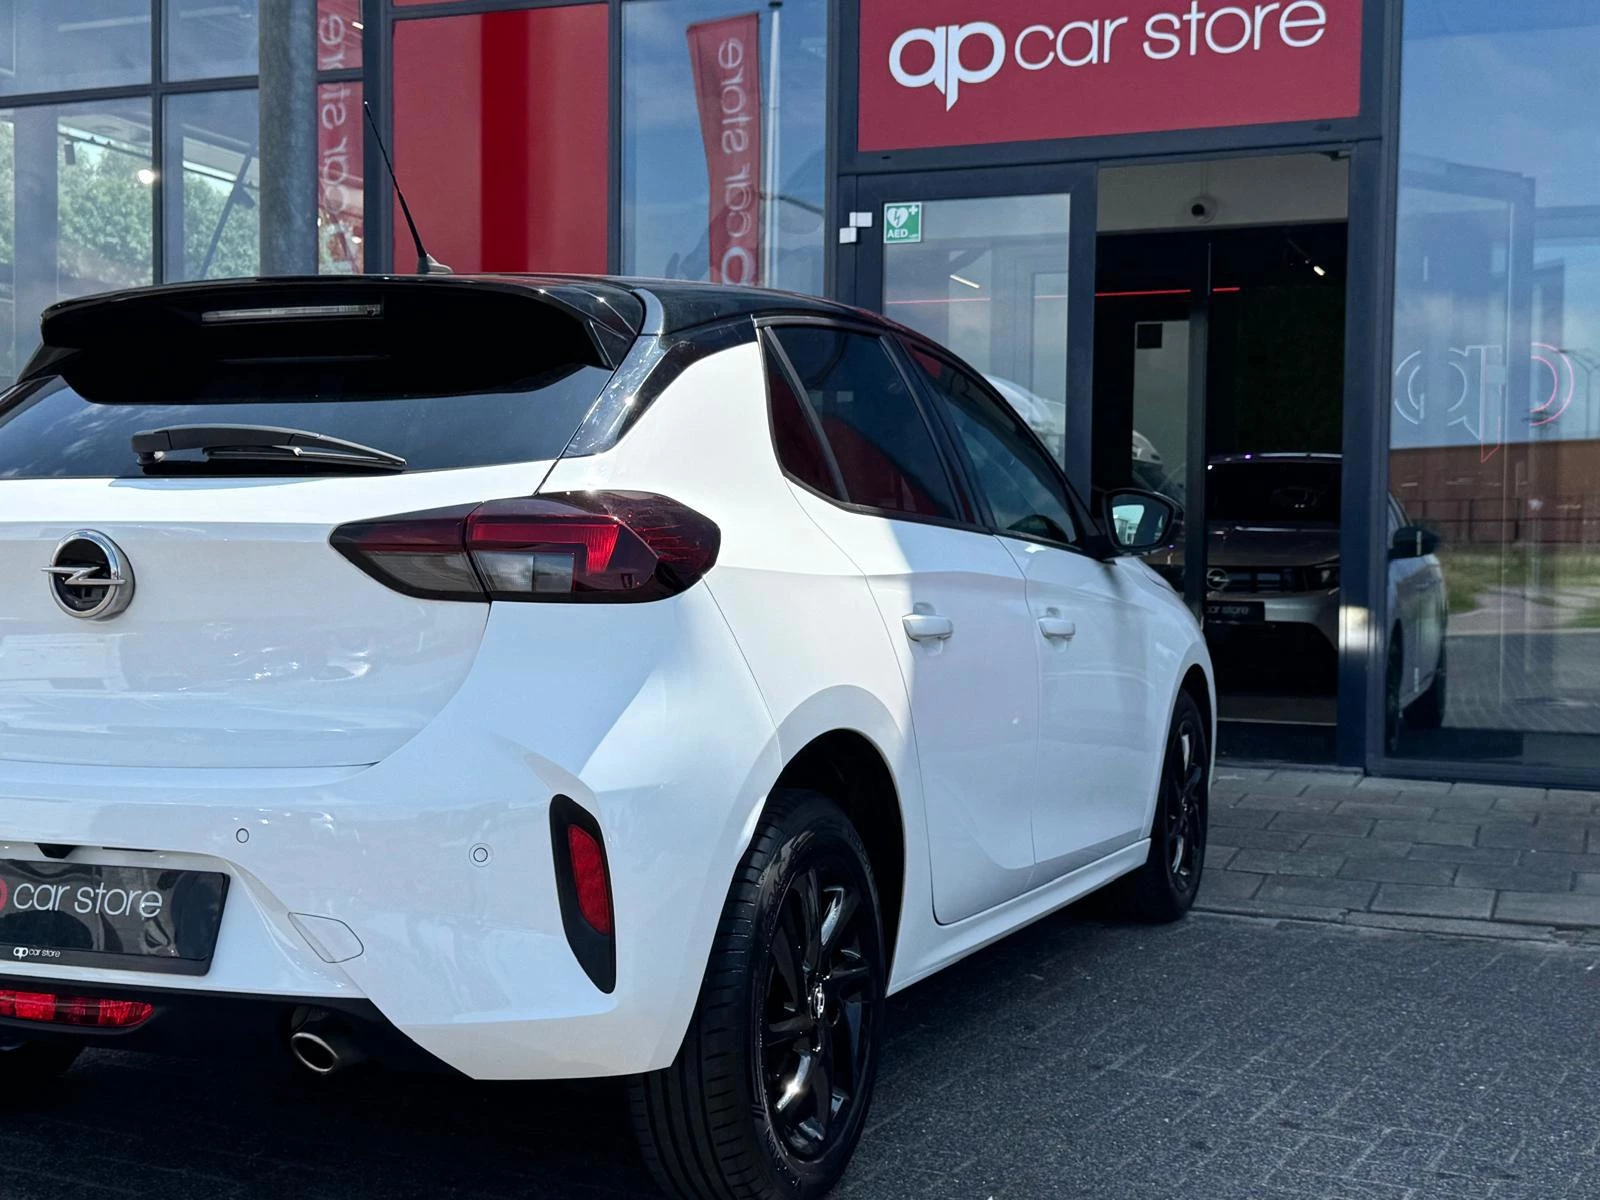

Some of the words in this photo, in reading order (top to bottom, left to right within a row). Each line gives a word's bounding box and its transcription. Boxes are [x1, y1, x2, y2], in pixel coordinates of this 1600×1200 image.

[888, 21, 1006, 112] ap
[1014, 16, 1128, 70] car
[1143, 0, 1327, 60] store
[887, 228, 908, 238] AED
[13, 882, 70, 911] car
[74, 882, 163, 918] store
[29, 948, 41, 956] car
[41, 949, 61, 958] store
